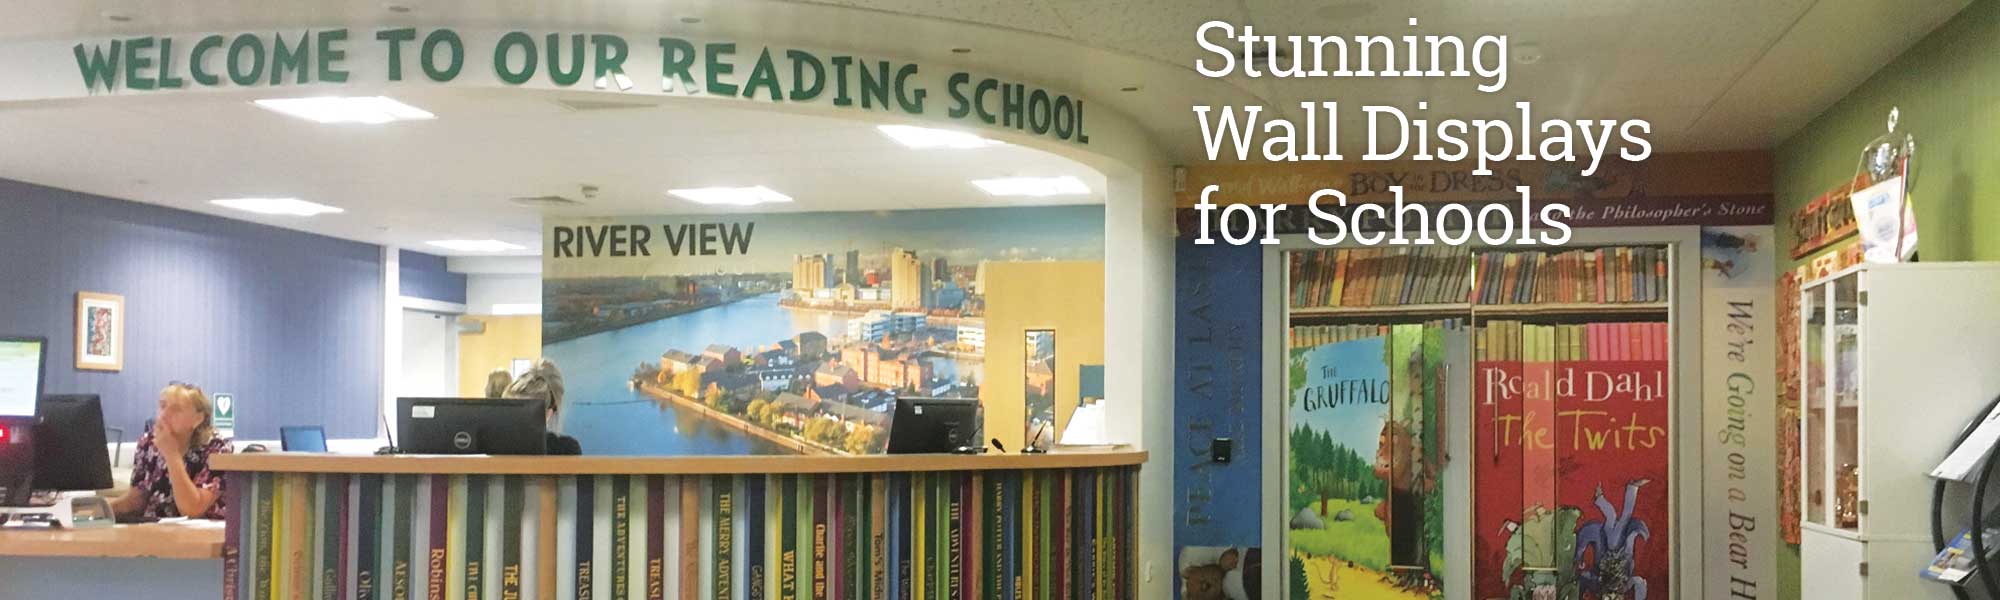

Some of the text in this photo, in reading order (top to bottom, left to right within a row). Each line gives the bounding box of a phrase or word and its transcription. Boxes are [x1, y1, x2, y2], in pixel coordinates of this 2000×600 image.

[73, 28, 1090, 144] WELCOME TO OUR READING SCHOOL
[1349, 171, 1409, 196] BOY
[1429, 168, 1522, 194] DRESS
[1601, 204, 1712, 221] Philosopher's
[1718, 202, 1766, 217] Stone
[553, 222, 755, 258] RIVER VIEW
[1727, 298, 1755, 362] We're
[1303, 378, 1390, 412] GRUFFALO
[1482, 367, 1665, 405] Roald Dahl
[1718, 371, 1756, 449] Going
[1493, 409, 1666, 451] The Twits
[1728, 452, 1747, 481] on
[720, 493, 731, 513] THE
[1728, 487, 1746, 503] a
[718, 517, 730, 554] MERRY
[874, 533, 884, 565] Tom's
[950, 502, 959, 597] THE ADVENTURES
[1728, 508, 1757, 569] Bear
[504, 564, 518, 586] THE
[615, 521, 625, 595] ADVENTURES
[783, 550, 794, 590] WHAT
[815, 523, 826, 597] Charlie and the
